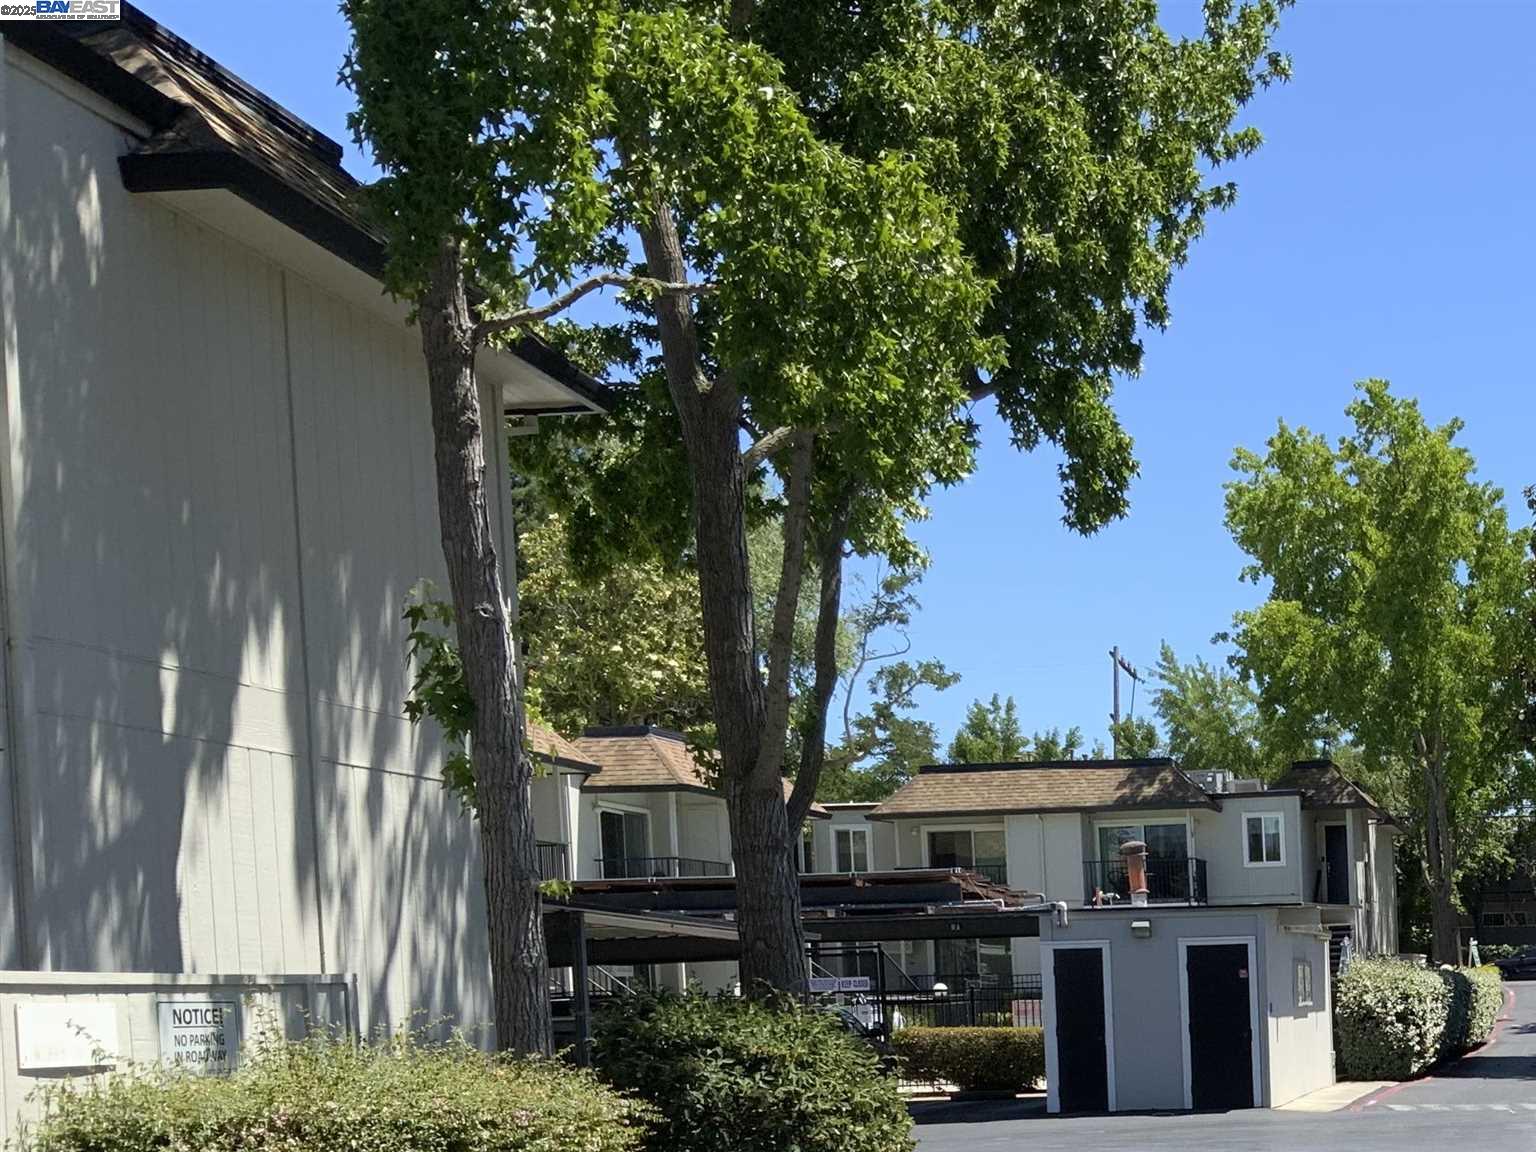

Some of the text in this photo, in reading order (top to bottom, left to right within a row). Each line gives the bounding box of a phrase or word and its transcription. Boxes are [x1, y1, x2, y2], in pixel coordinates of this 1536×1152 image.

[172, 1008, 224, 1025] NOTICE!
[174, 1033, 225, 1047] NO PARKING
